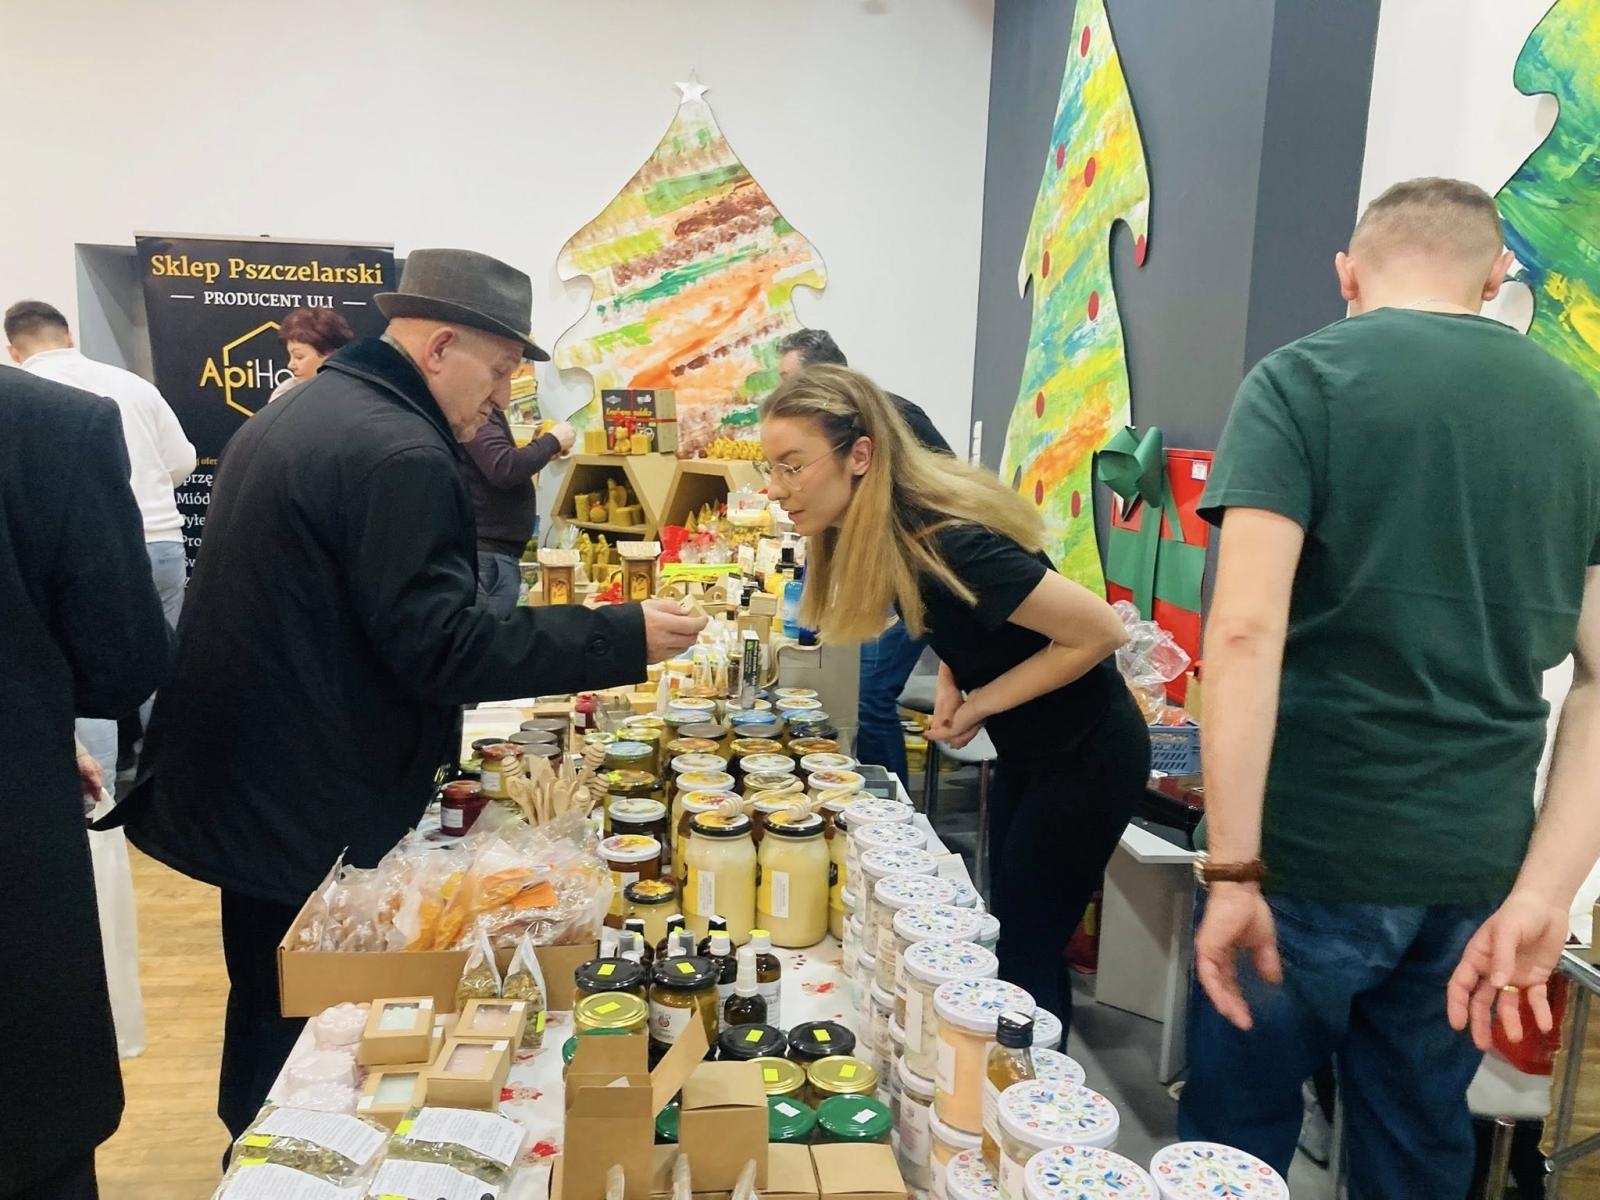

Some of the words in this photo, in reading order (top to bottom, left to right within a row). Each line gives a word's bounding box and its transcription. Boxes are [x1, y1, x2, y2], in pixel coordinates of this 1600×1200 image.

[151, 255, 220, 283] Sklep
[228, 258, 384, 285] Pszczelarski
[203, 291, 302, 308] PRODUCENT
[307, 295, 334, 309] ULI
[176, 492, 211, 505] Miód
